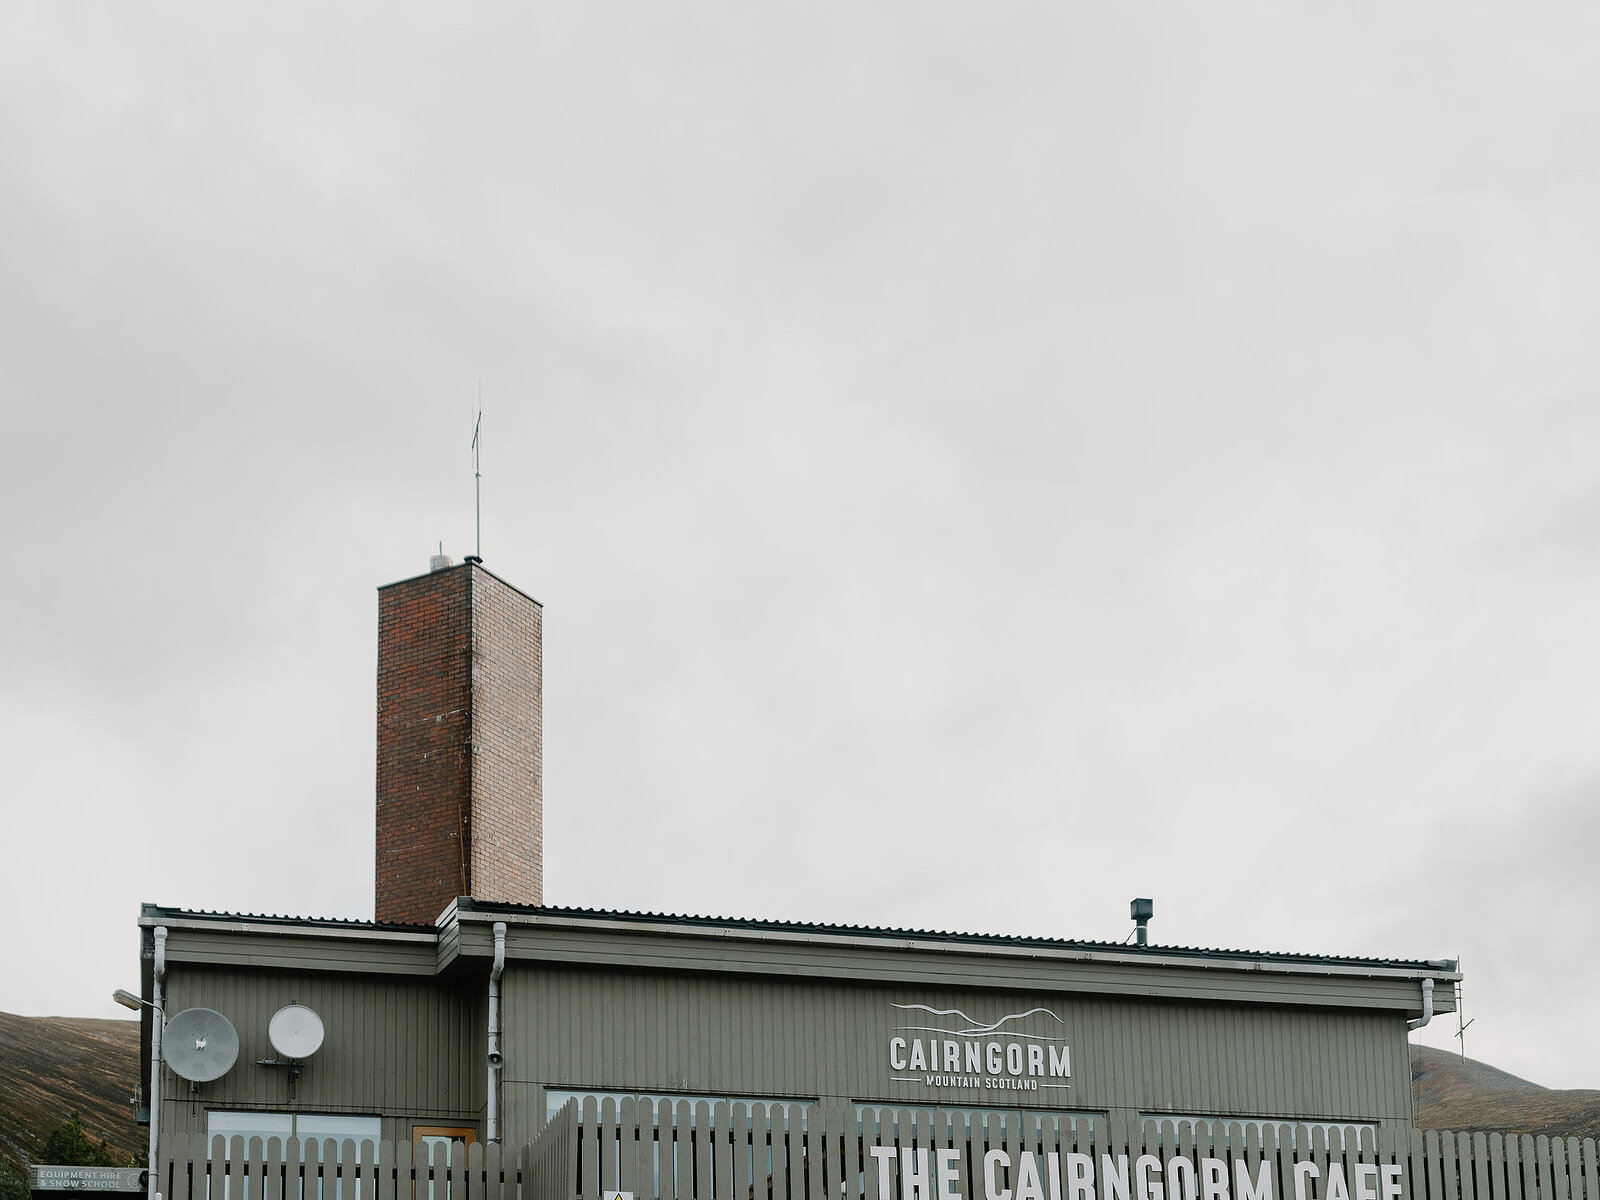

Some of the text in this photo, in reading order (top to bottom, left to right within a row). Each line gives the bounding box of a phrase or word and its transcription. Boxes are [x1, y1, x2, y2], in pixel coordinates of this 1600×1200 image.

[890, 1037, 1071, 1078] CAIRNGORM
[926, 1075, 1037, 1091] MOUNTAIN SCOTLAND
[40, 1171, 122, 1180] EQUIPMENT HIRE
[49, 1180, 79, 1188] SNOW
[81, 1181, 121, 1189] SCHOOL
